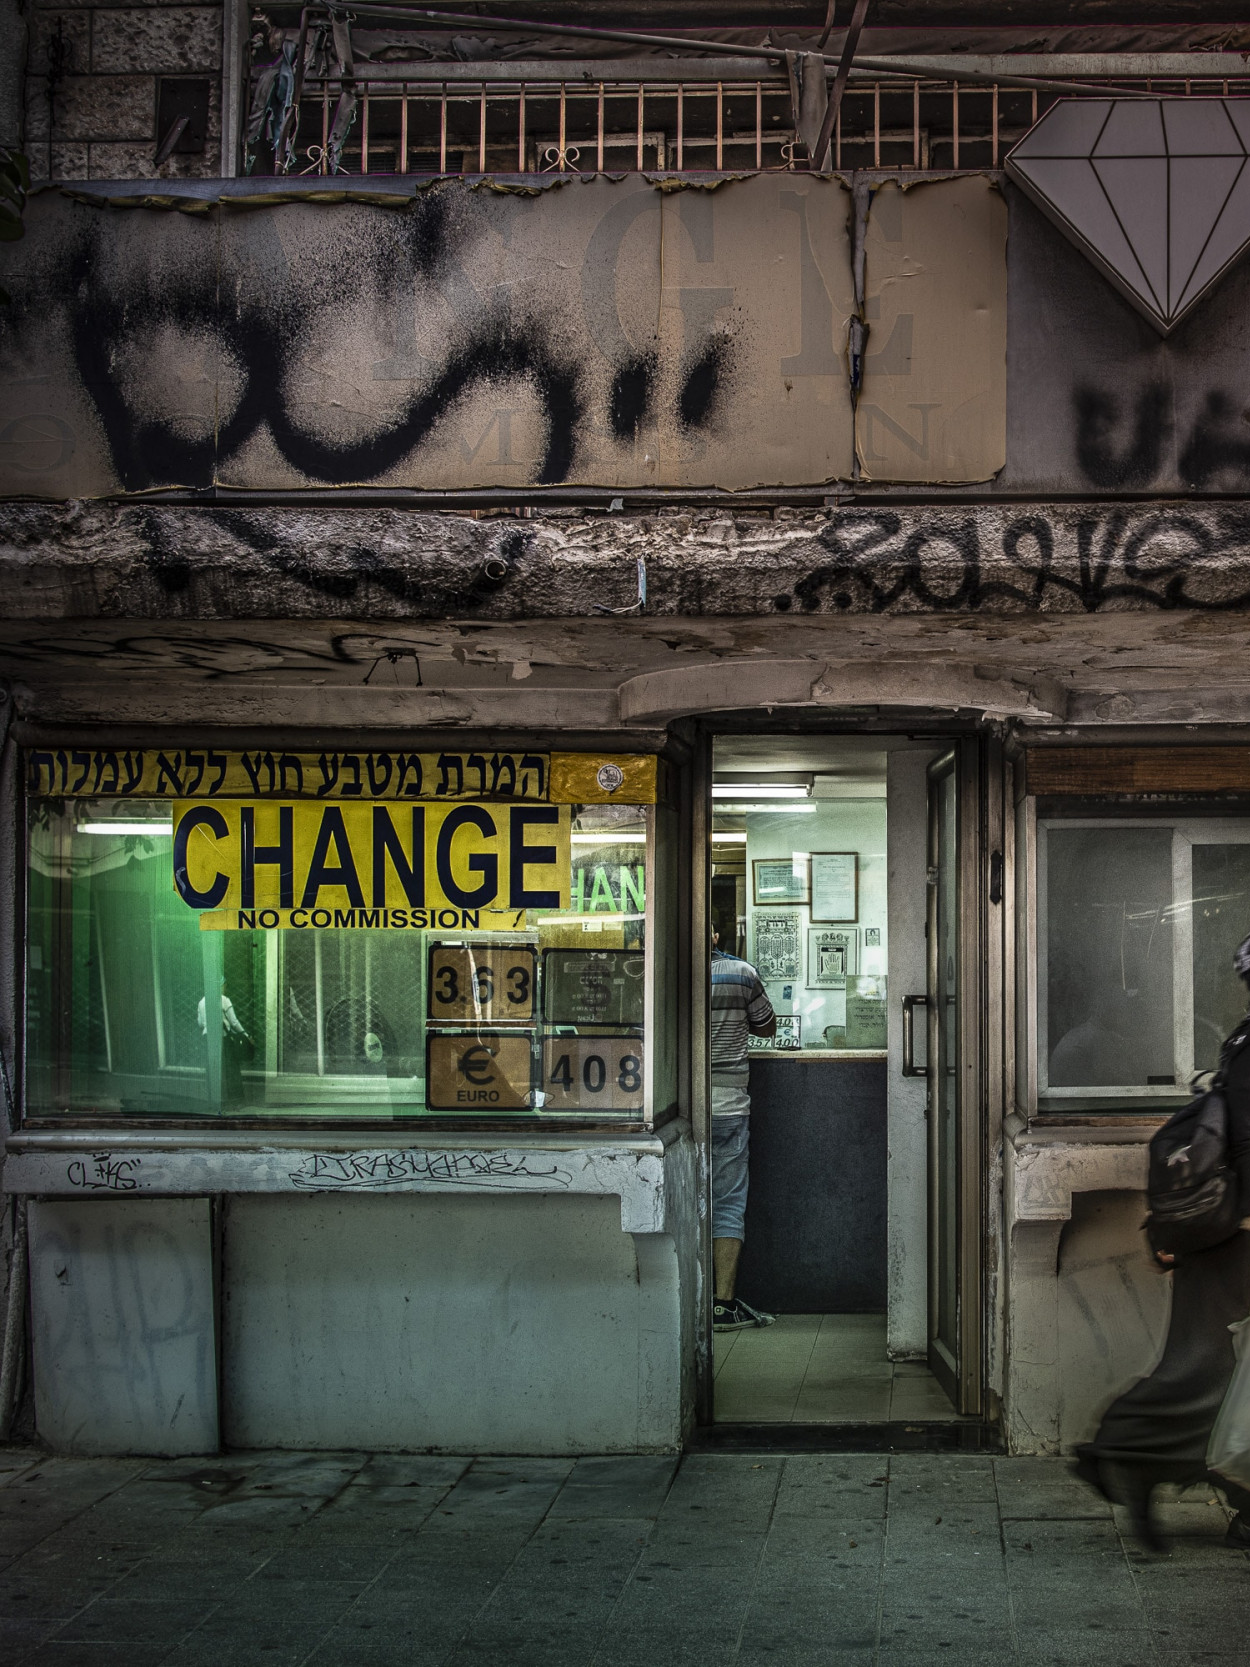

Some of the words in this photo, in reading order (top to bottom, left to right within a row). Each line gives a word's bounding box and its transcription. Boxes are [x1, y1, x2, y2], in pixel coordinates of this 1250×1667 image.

[29, 750, 143, 794] עמלות
[156, 750, 227, 796] ללא
[240, 751, 303, 795] חוץ
[317, 752, 422, 796] מטבע
[435, 752, 544, 796] המרת
[173, 805, 561, 909] CHANGE
[238, 910, 280, 929] NO
[289, 909, 480, 929] COMMISSION
[457, 1090, 500, 1103] EURO
